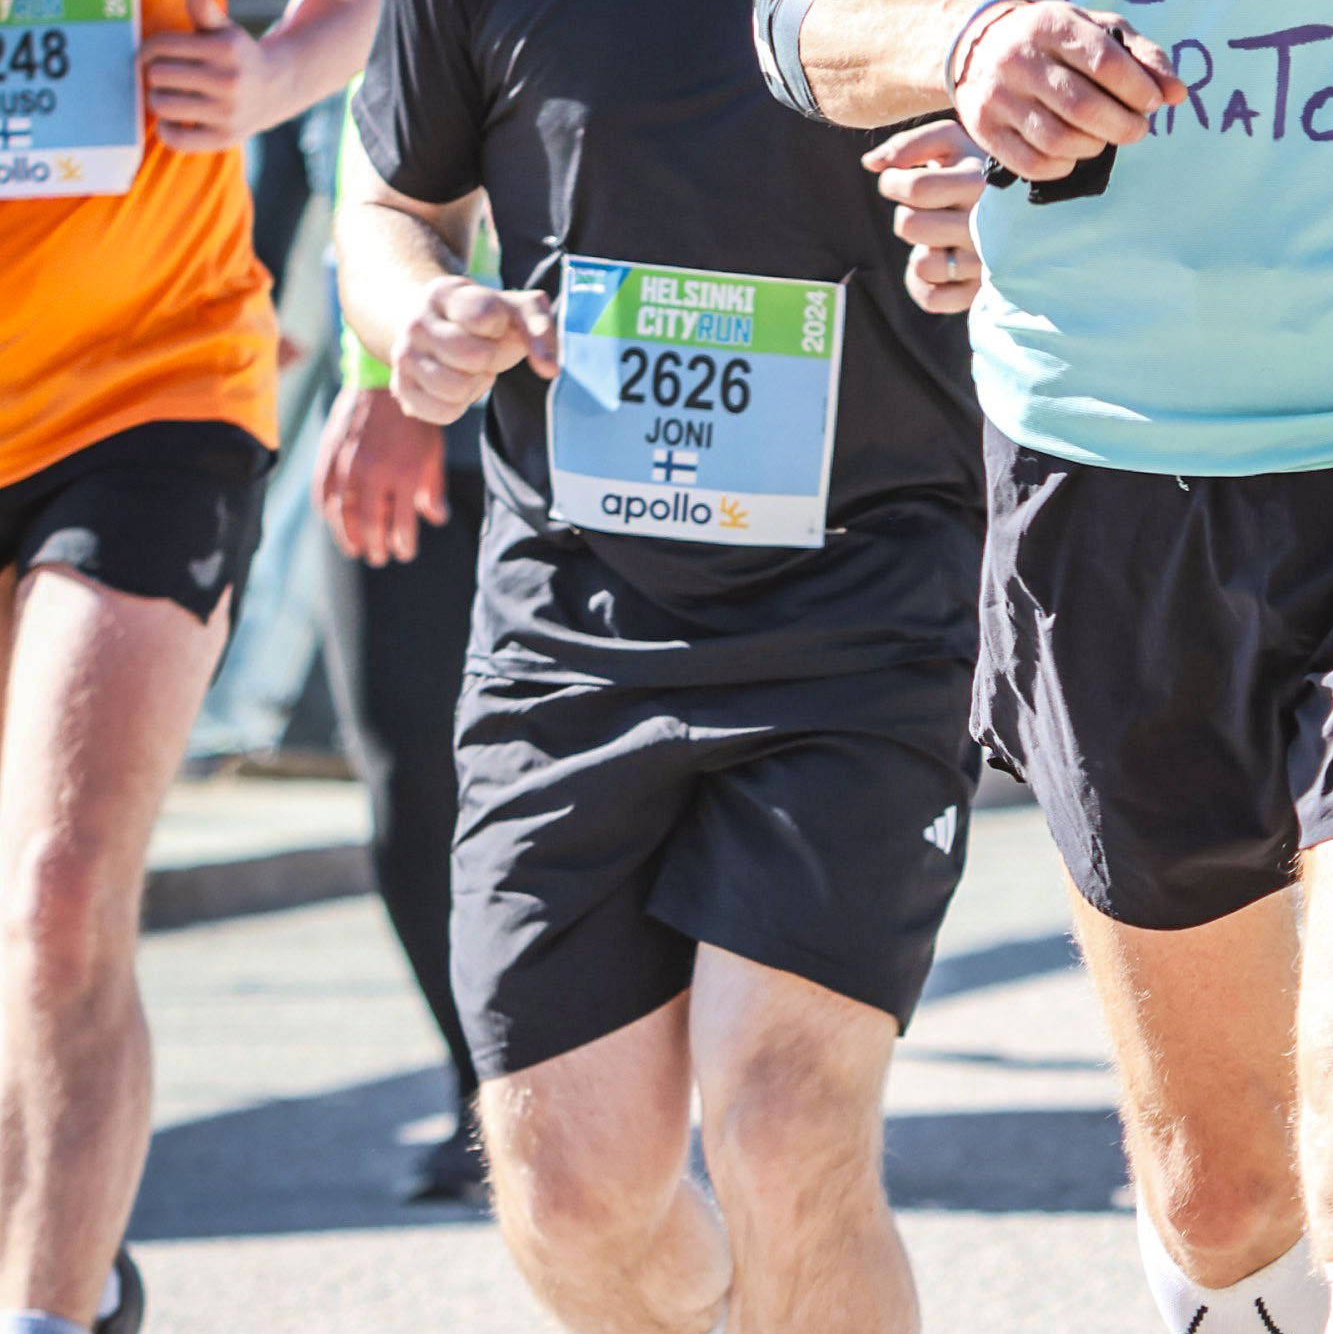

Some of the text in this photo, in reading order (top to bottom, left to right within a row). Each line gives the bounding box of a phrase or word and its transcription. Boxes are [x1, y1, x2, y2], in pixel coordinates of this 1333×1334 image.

[0, 29, 69, 80] 48
[640, 275, 755, 313] HELSINKI
[801, 290, 827, 353] 2024
[619, 346, 752, 415] 2626
[645, 417, 714, 449] JONI
[601, 492, 712, 524] apollo
